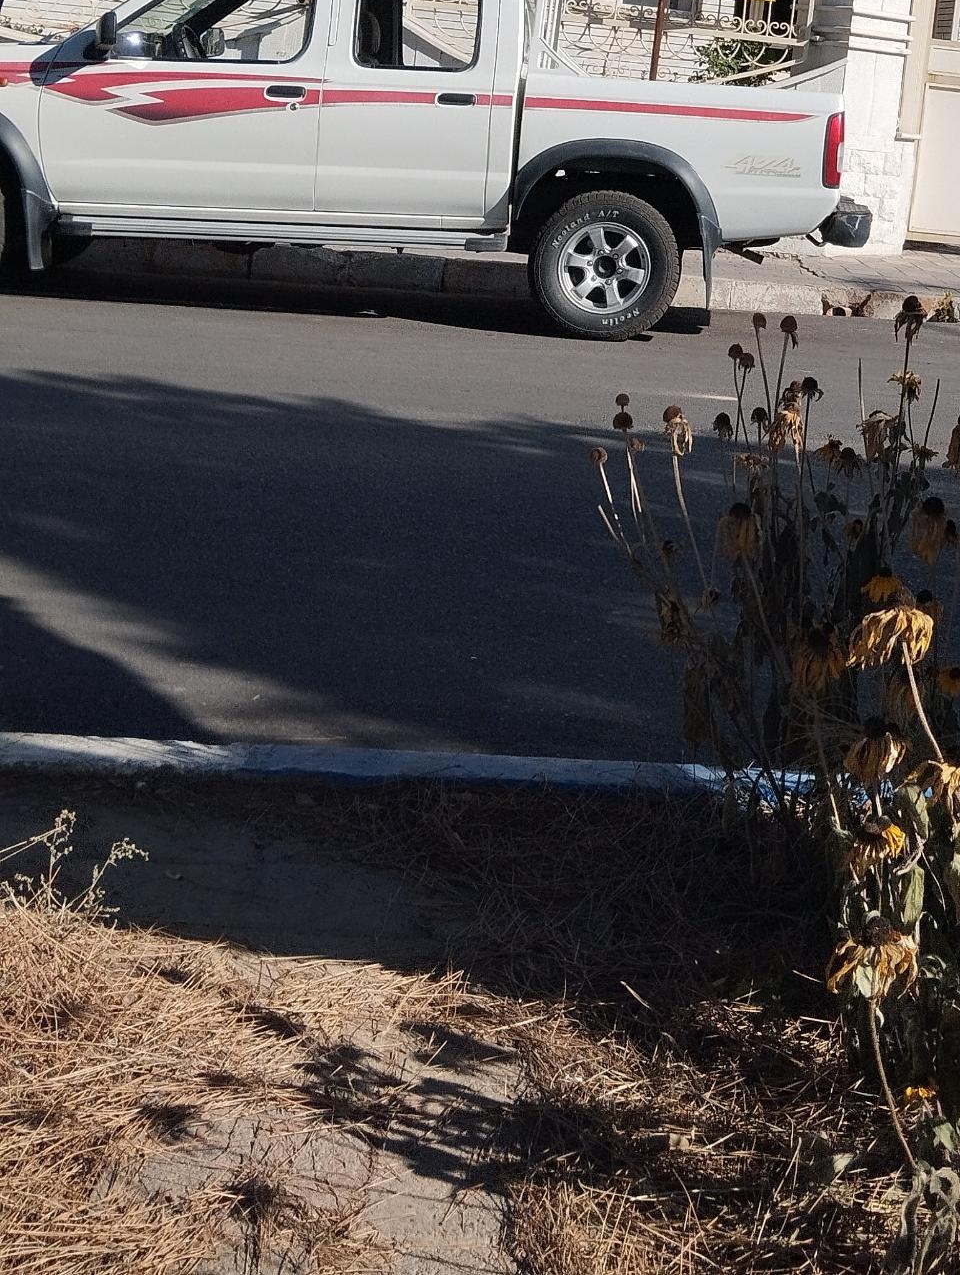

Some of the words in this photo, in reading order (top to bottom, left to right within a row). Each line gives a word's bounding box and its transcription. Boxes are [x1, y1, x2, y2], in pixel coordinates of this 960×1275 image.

[551, 213, 591, 250] Neoland
[597, 209, 620, 218] A/T
[602, 307, 640, 326] Neolin
